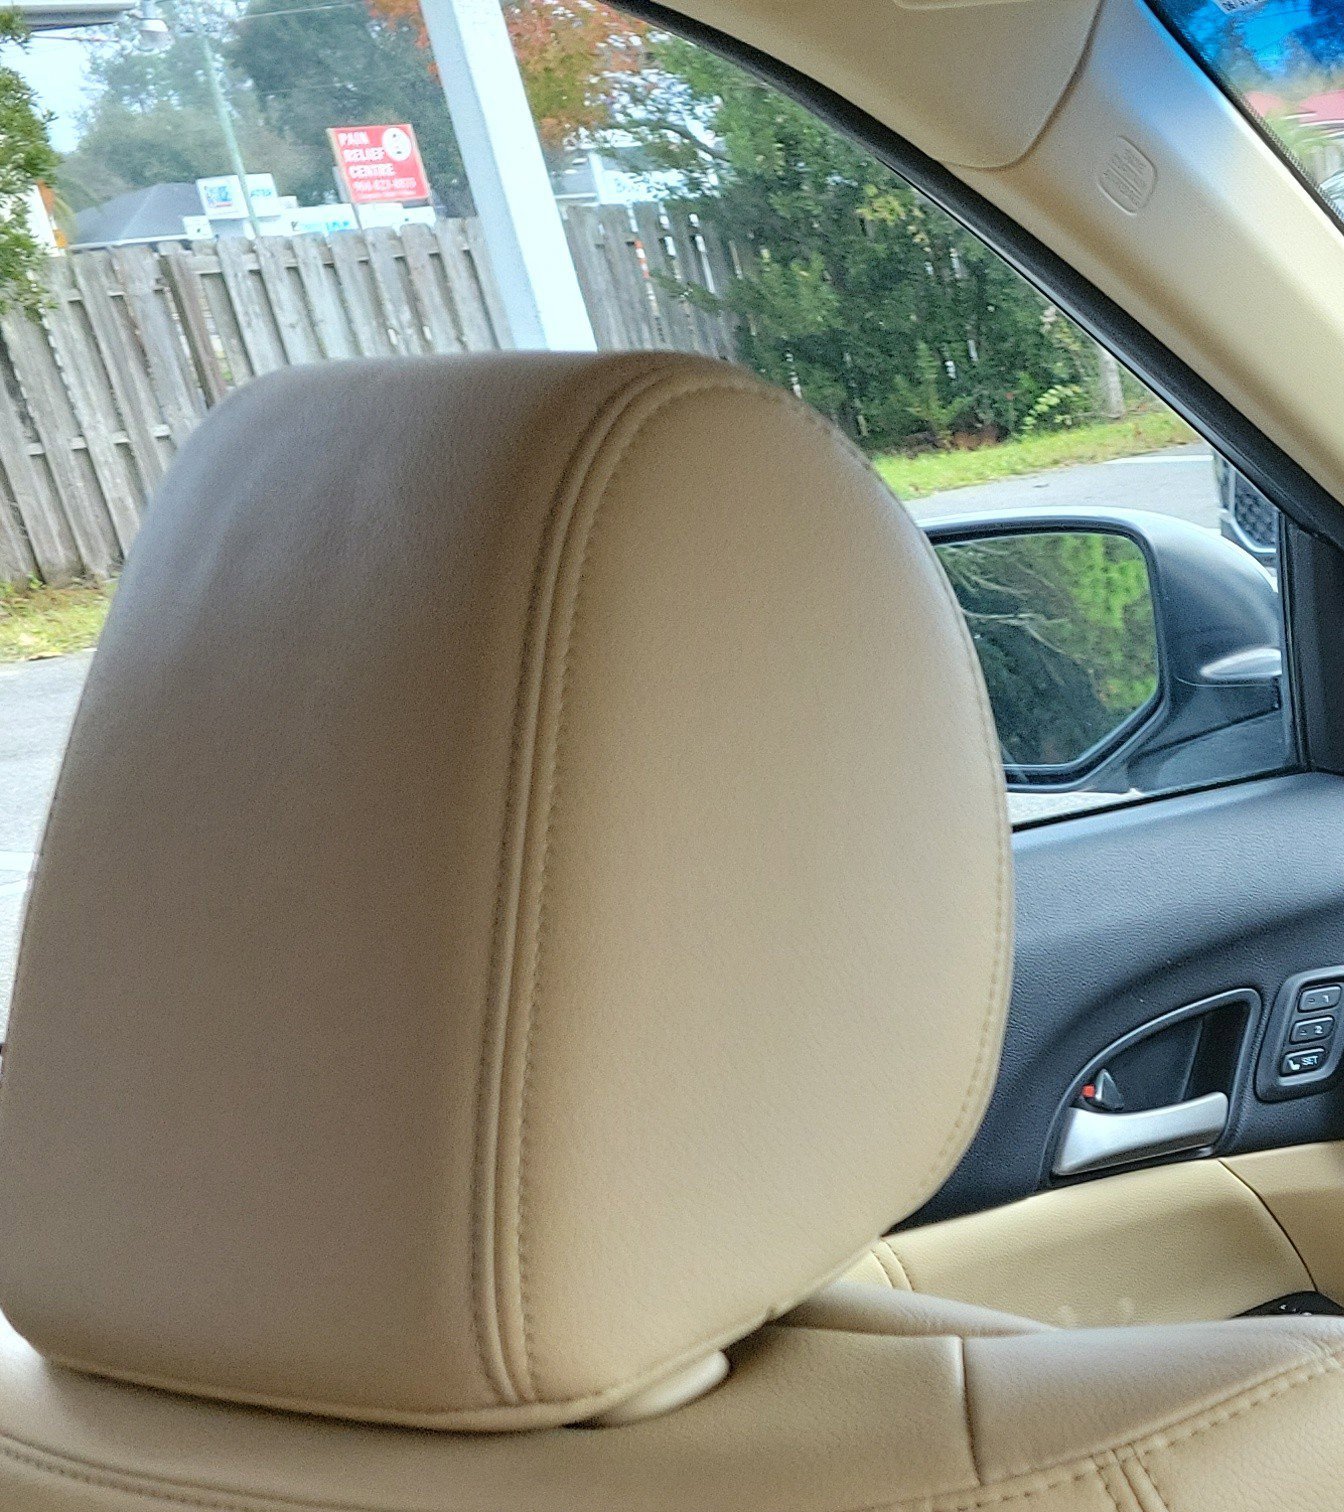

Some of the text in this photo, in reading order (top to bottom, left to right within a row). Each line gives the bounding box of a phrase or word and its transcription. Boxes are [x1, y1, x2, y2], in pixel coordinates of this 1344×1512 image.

[338, 131, 370, 146] PAIN
[343, 147, 385, 162] RELIEF
[1315, 1025, 1323, 1034] 2
